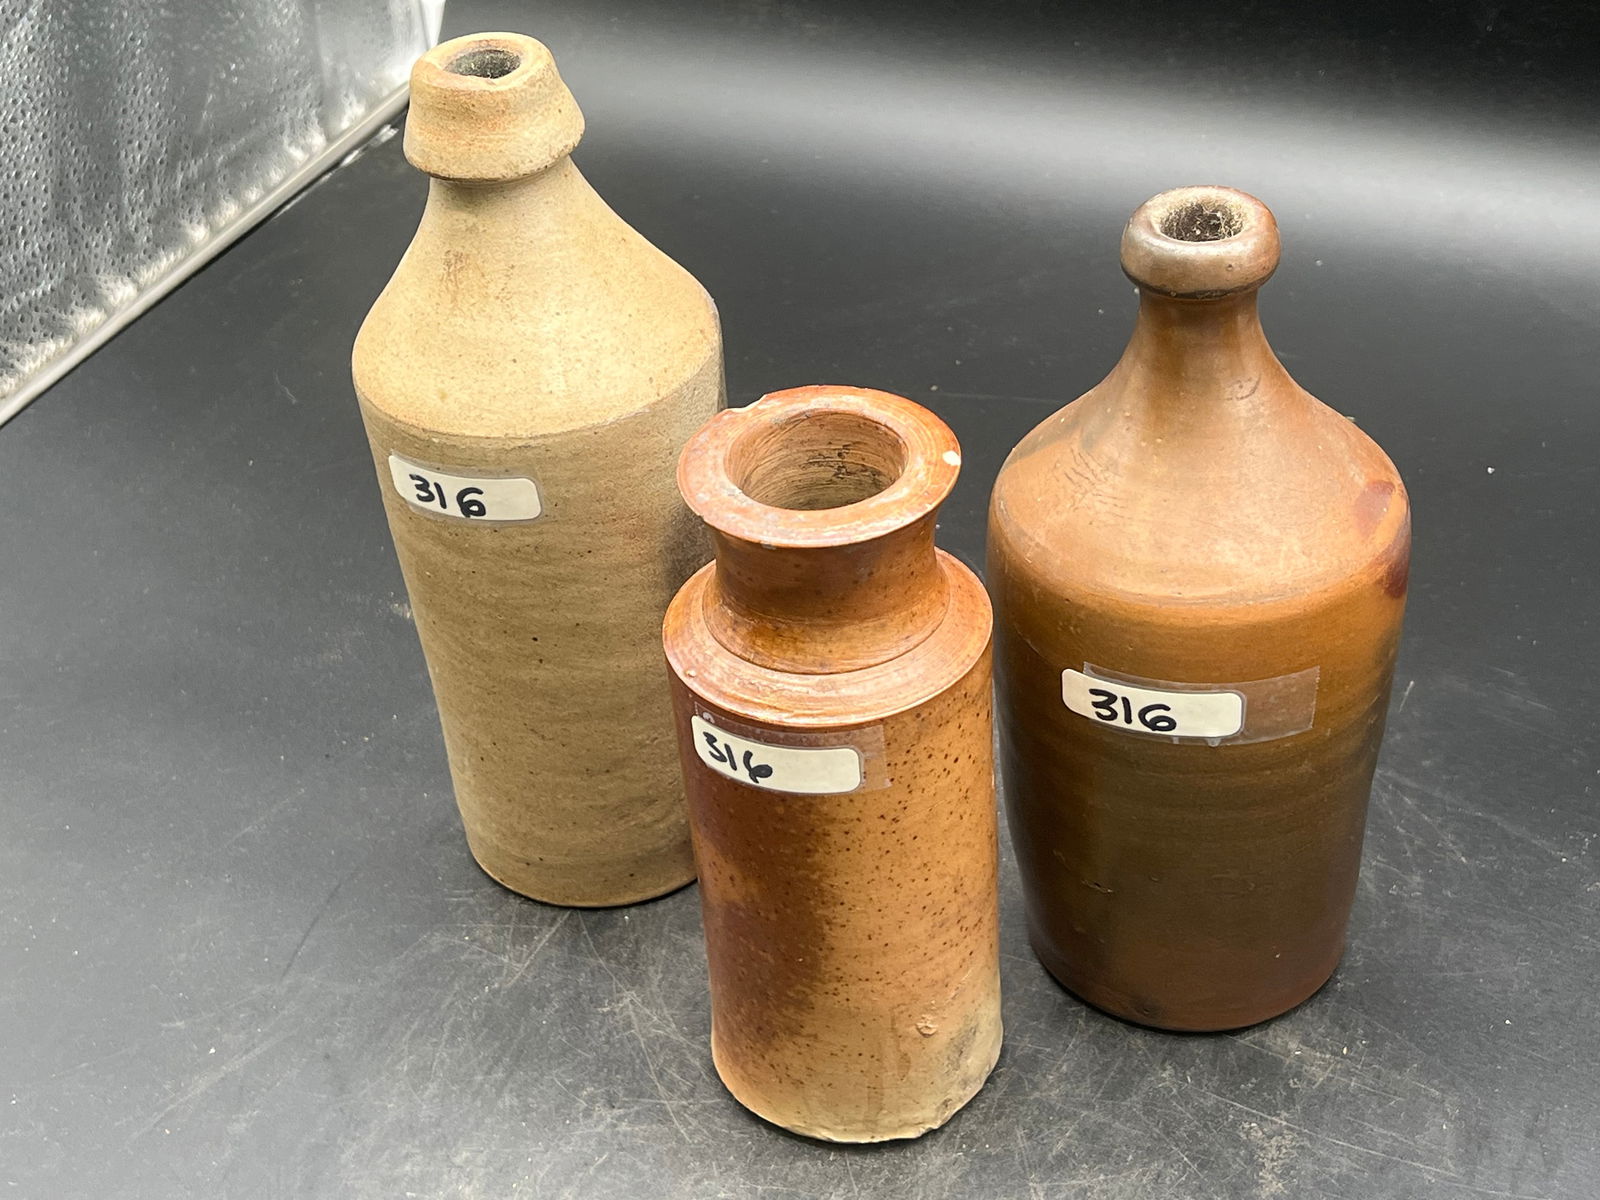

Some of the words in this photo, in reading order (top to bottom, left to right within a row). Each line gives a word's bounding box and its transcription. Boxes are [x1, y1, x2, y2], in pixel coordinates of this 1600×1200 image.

[409, 473, 487, 519] 316
[1088, 688, 1177, 732] 316
[702, 731, 773, 784] 316
